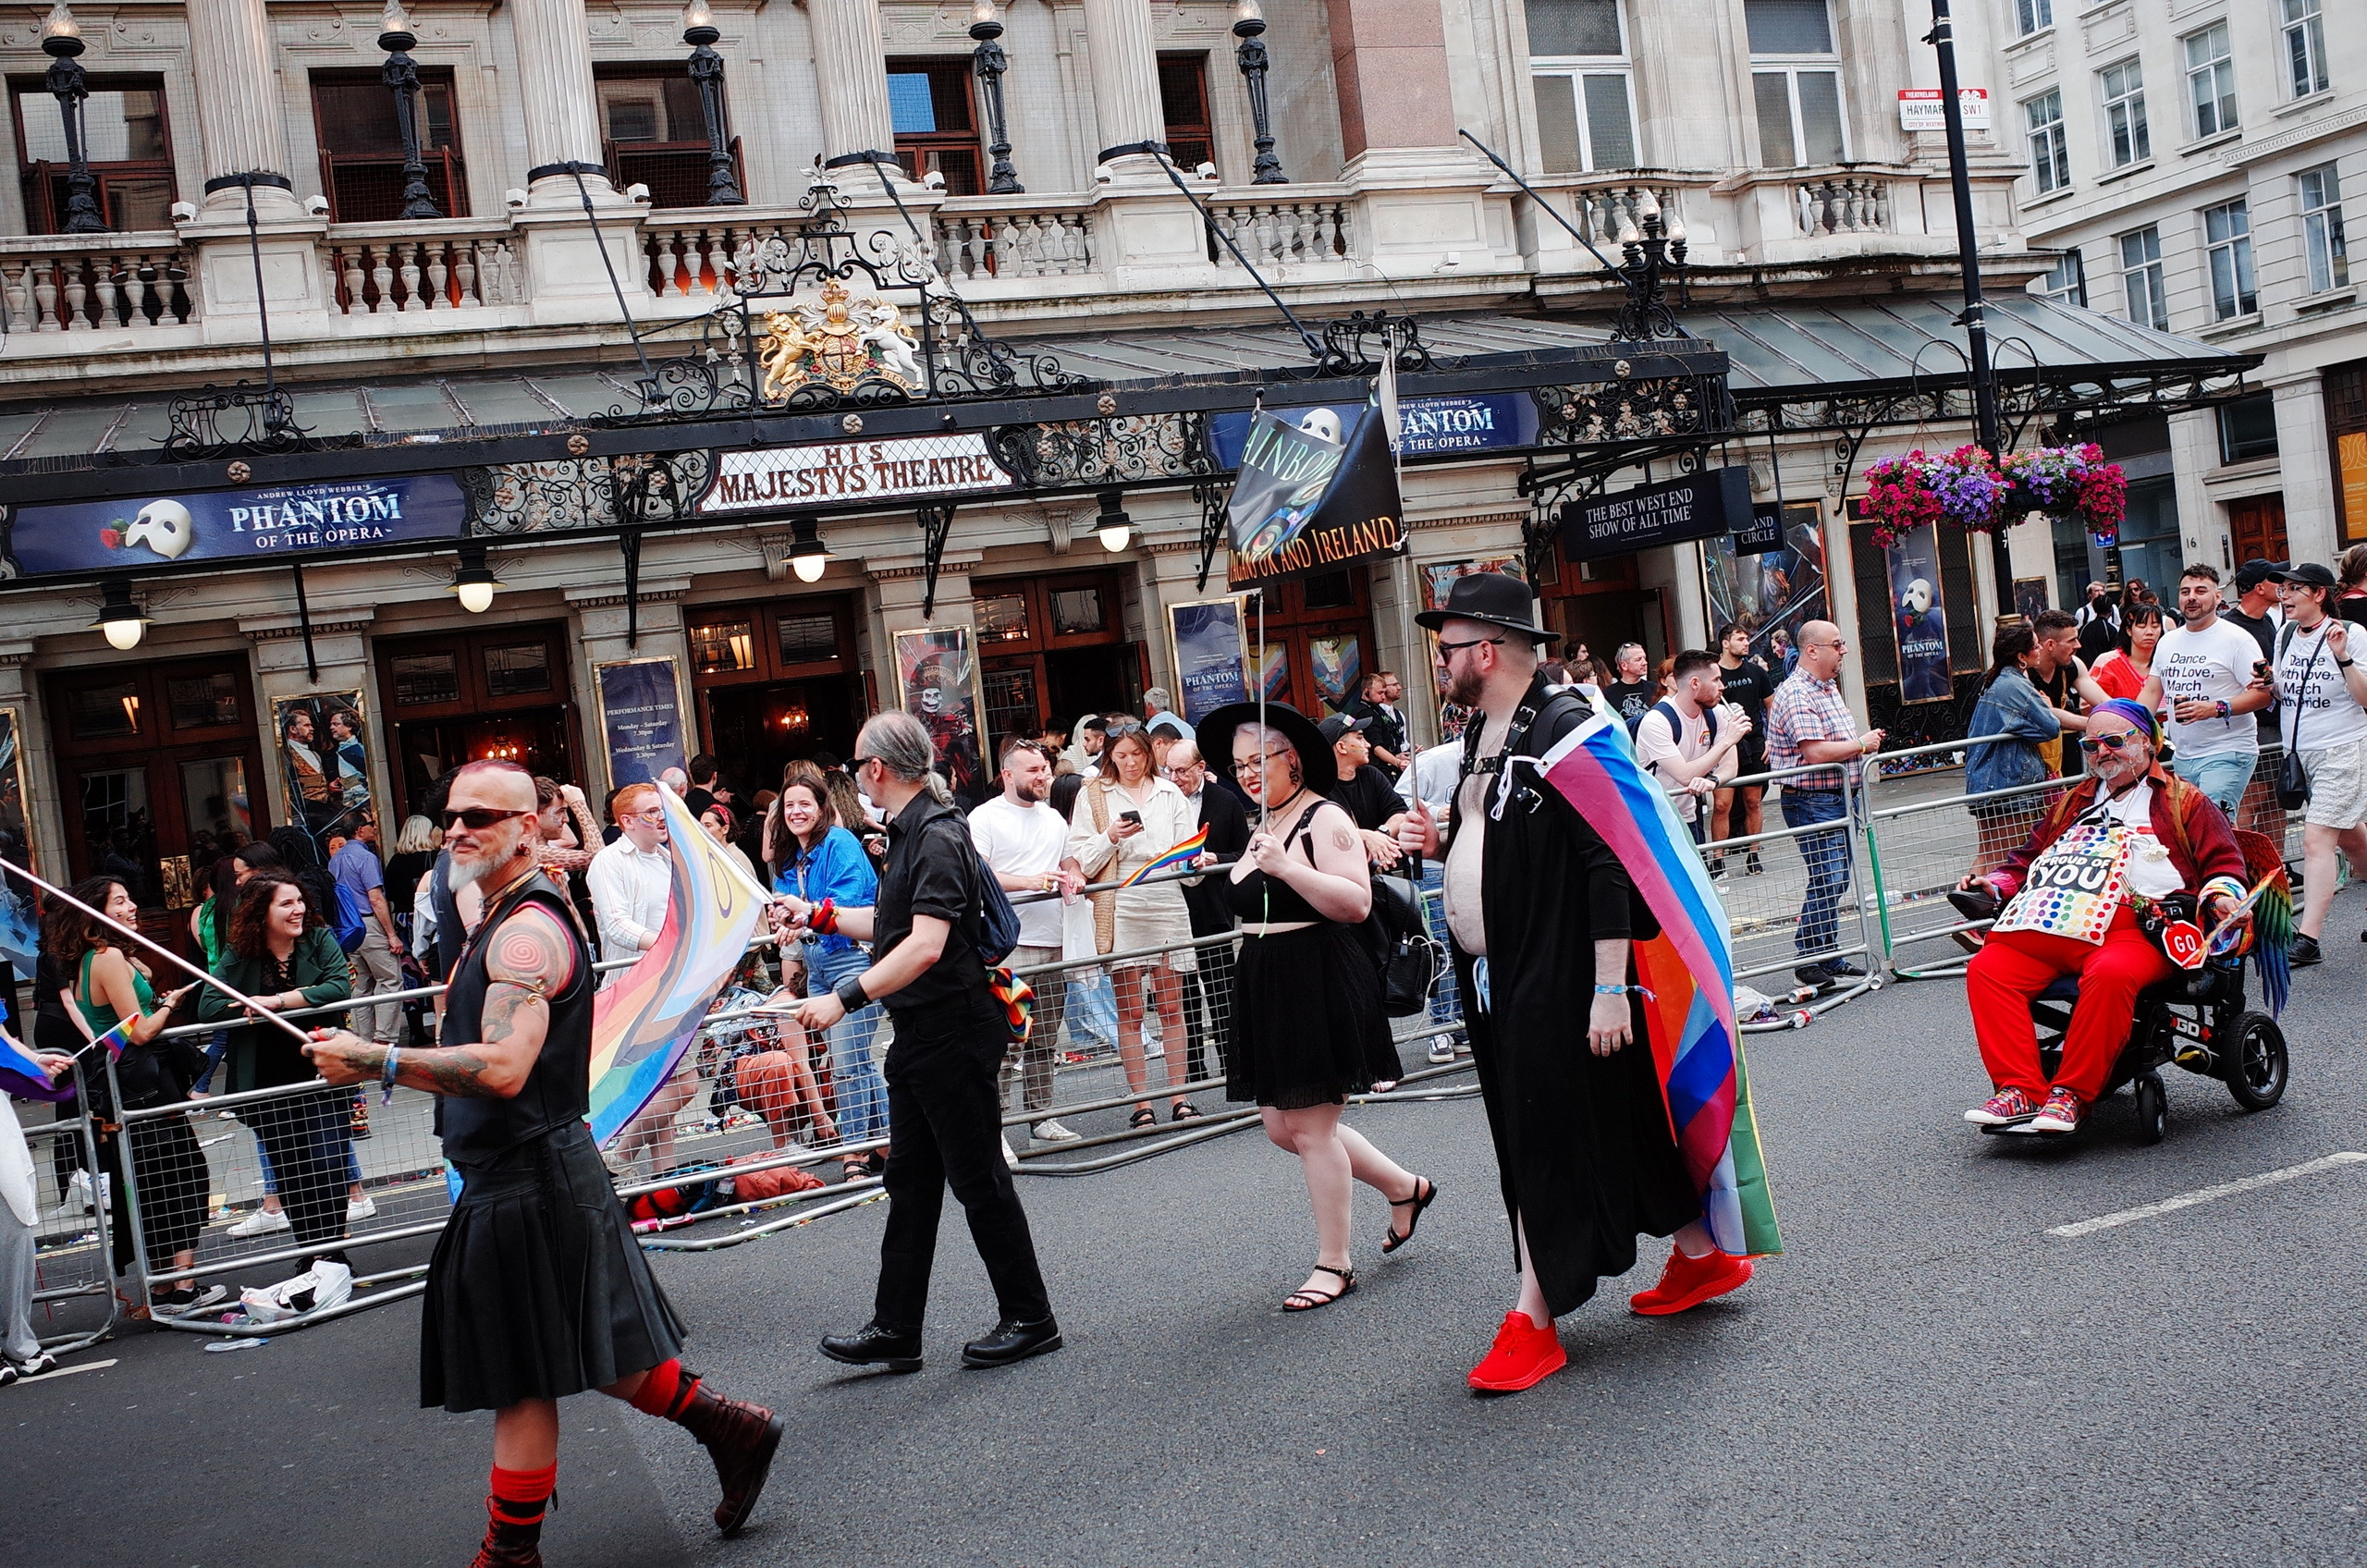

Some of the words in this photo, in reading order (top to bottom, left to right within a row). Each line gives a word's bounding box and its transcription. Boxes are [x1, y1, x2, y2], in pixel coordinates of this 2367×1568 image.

[1907, 104, 1945, 116] HAYMAR
[1963, 104, 1981, 116] SW1
[1397, 407, 1495, 435] ANTOM
[1409, 439, 1434, 450] THE
[1439, 435, 1481, 448] OPERA
[825, 444, 883, 465] HIS
[873, 454, 993, 489] THEATRE
[257, 491, 293, 500] ANDREW
[296, 488, 325, 496] LLOYD
[327, 484, 372, 494] WEBBER'S
[228, 493, 403, 533] PHANTOM
[1586, 506, 1607, 524] THE
[1609, 501, 1634, 519] BEST
[1636, 494, 1667, 513] WEST
[1669, 487, 1693, 505] END
[1588, 521, 1620, 540] SHOW
[1622, 519, 1637, 533] OF
[1638, 514, 1660, 530] ALL
[1754, 516, 1774, 529] AND
[255, 535, 278, 549] OF
[285, 531, 320, 546] THE
[325, 526, 385, 543] OPERA
[1280, 538, 1311, 573] AND
[1311, 516, 1396, 564] IRELAND
[1741, 529, 1775, 545] CIRCLE
[2186, 537, 2197, 548] 16
[1902, 641, 1944, 654] PHANTOM
[2169, 652, 2207, 664] Dance
[1185, 671, 1239, 687] PHANTOM
[2182, 665, 2215, 680] Love,
[2166, 680, 2201, 692] March
[2283, 681, 2322, 695] Mach
[2281, 694, 2297, 707] ith
[607, 705, 654, 716] PERFORMANCE
[654, 703, 674, 711] TIMES
[617, 723, 639, 731] Monday
[644, 720, 668, 729] Saturday
[615, 744, 645, 753] Wednesday
[651, 741, 676, 750] Saturday
[2042, 854, 2089, 866] PROUD
[2091, 858, 2112, 868] OF
[2037, 864, 2108, 890] YOU
[2174, 934, 2197, 953] GO
[2176, 1017, 2200, 1037] GO
